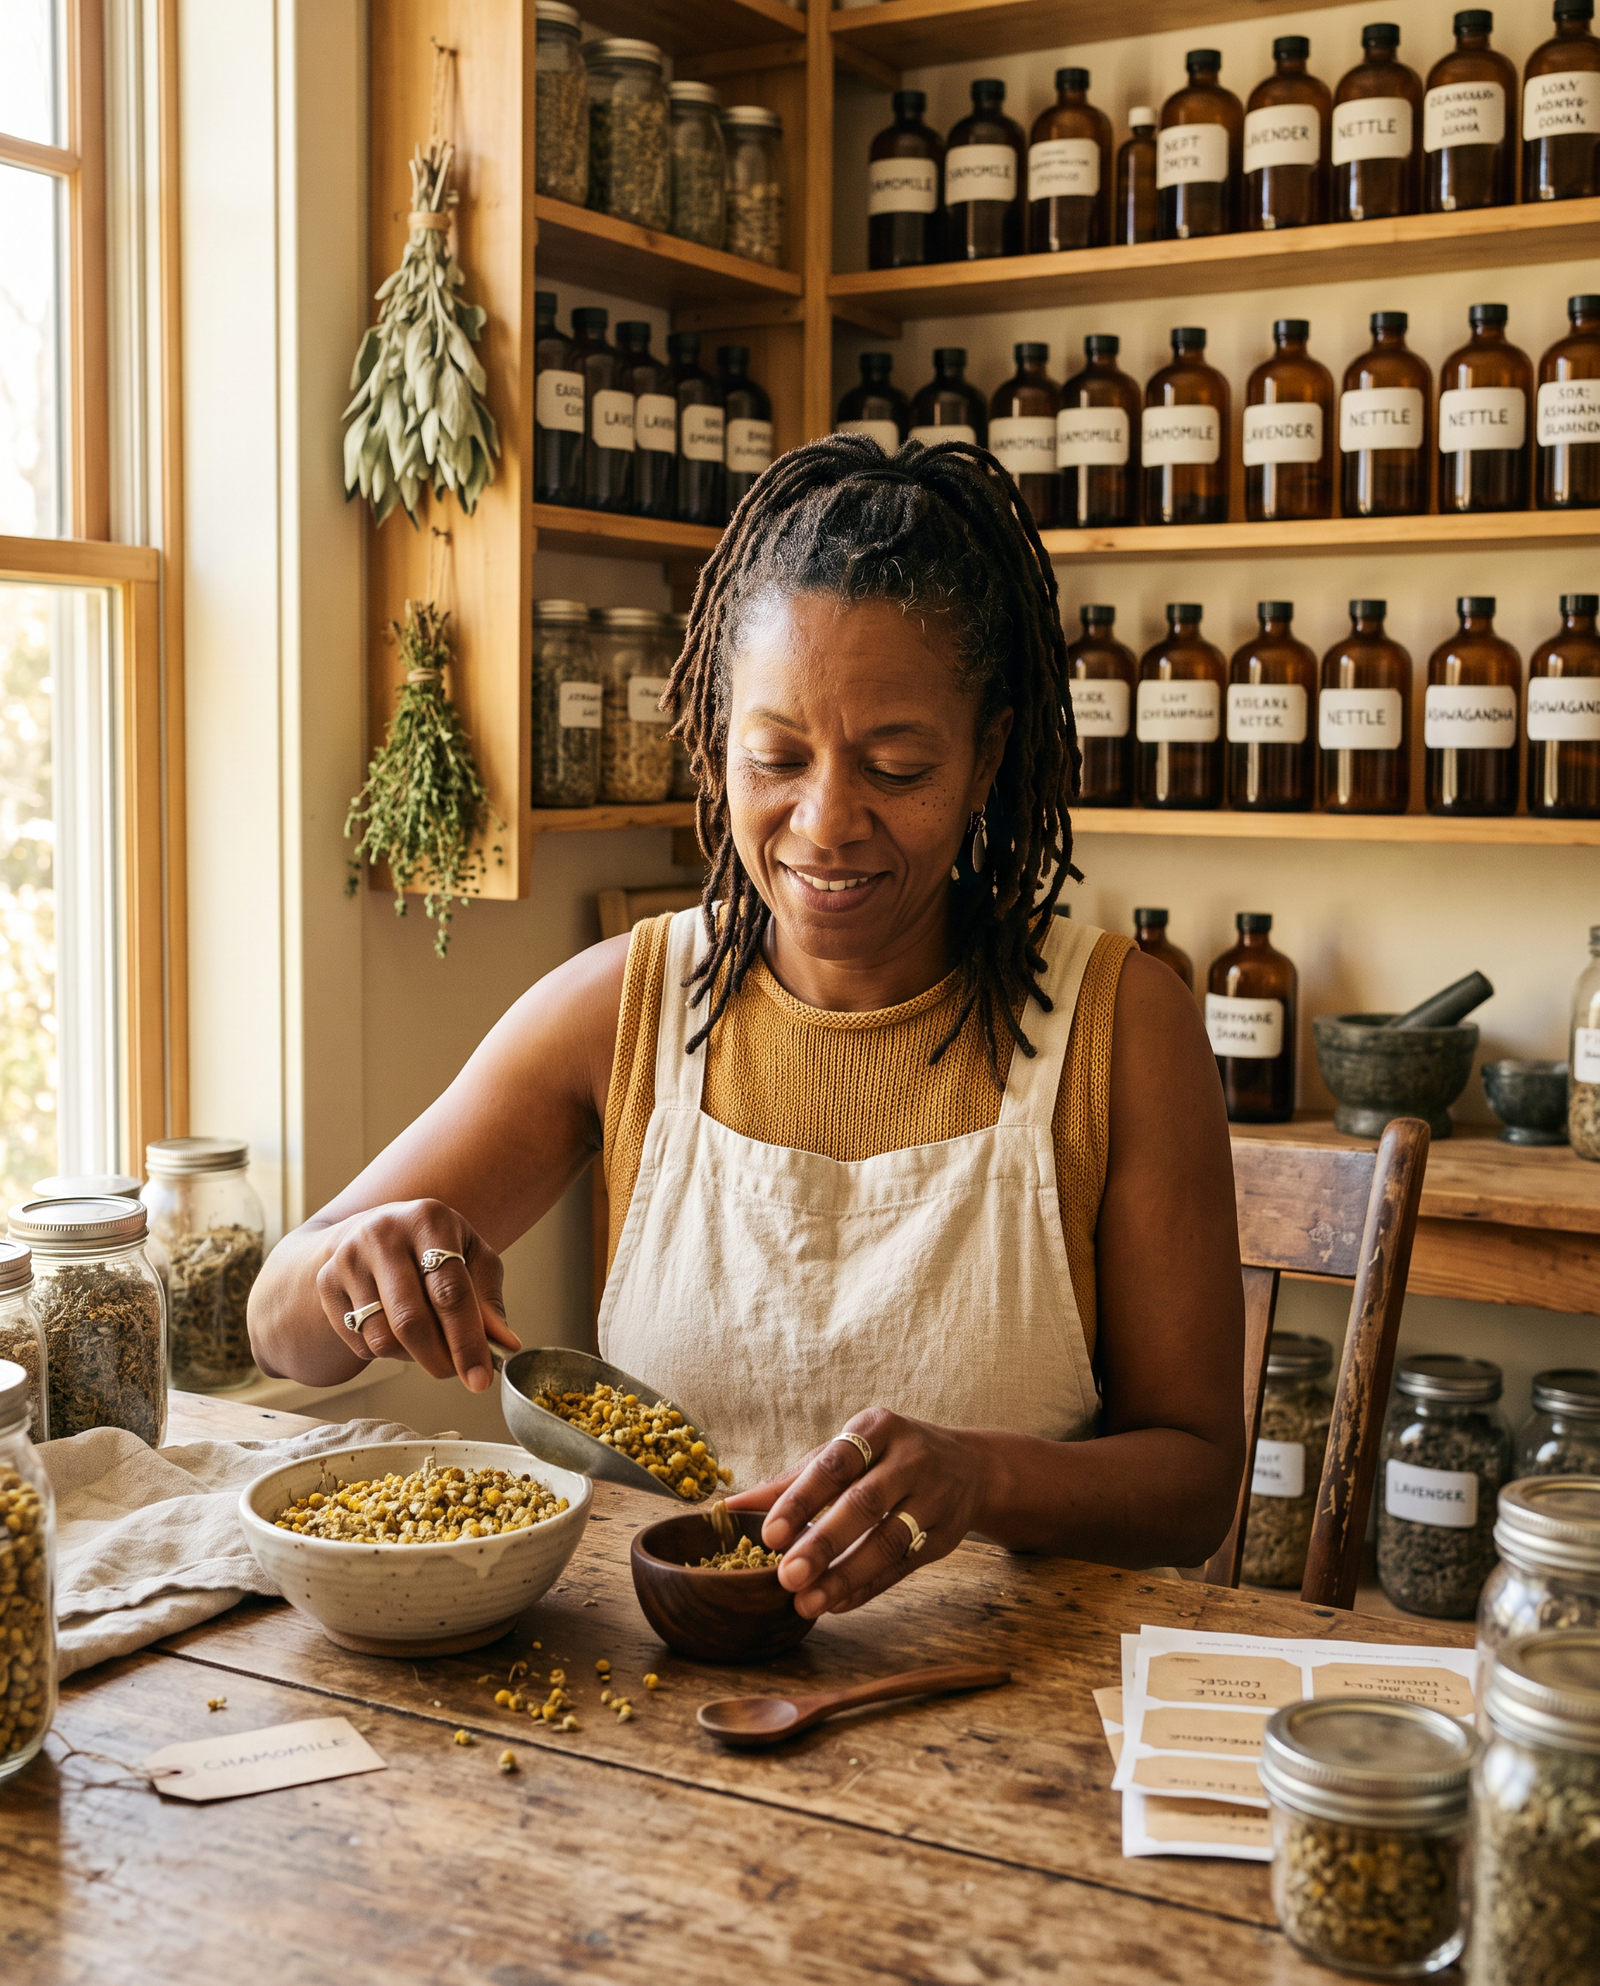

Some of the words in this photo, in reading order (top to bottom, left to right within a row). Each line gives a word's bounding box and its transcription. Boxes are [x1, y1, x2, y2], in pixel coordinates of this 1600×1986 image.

[1338, 118, 1397, 139] NETTLE
[1350, 408, 1411, 427] NETTLE
[1449, 408, 1509, 427] NETTLE
[1328, 709, 1386, 726] NETTLE
[1394, 1480, 1466, 1503] LAVENDER
[204, 1738, 349, 1771] CHAMOMILE
